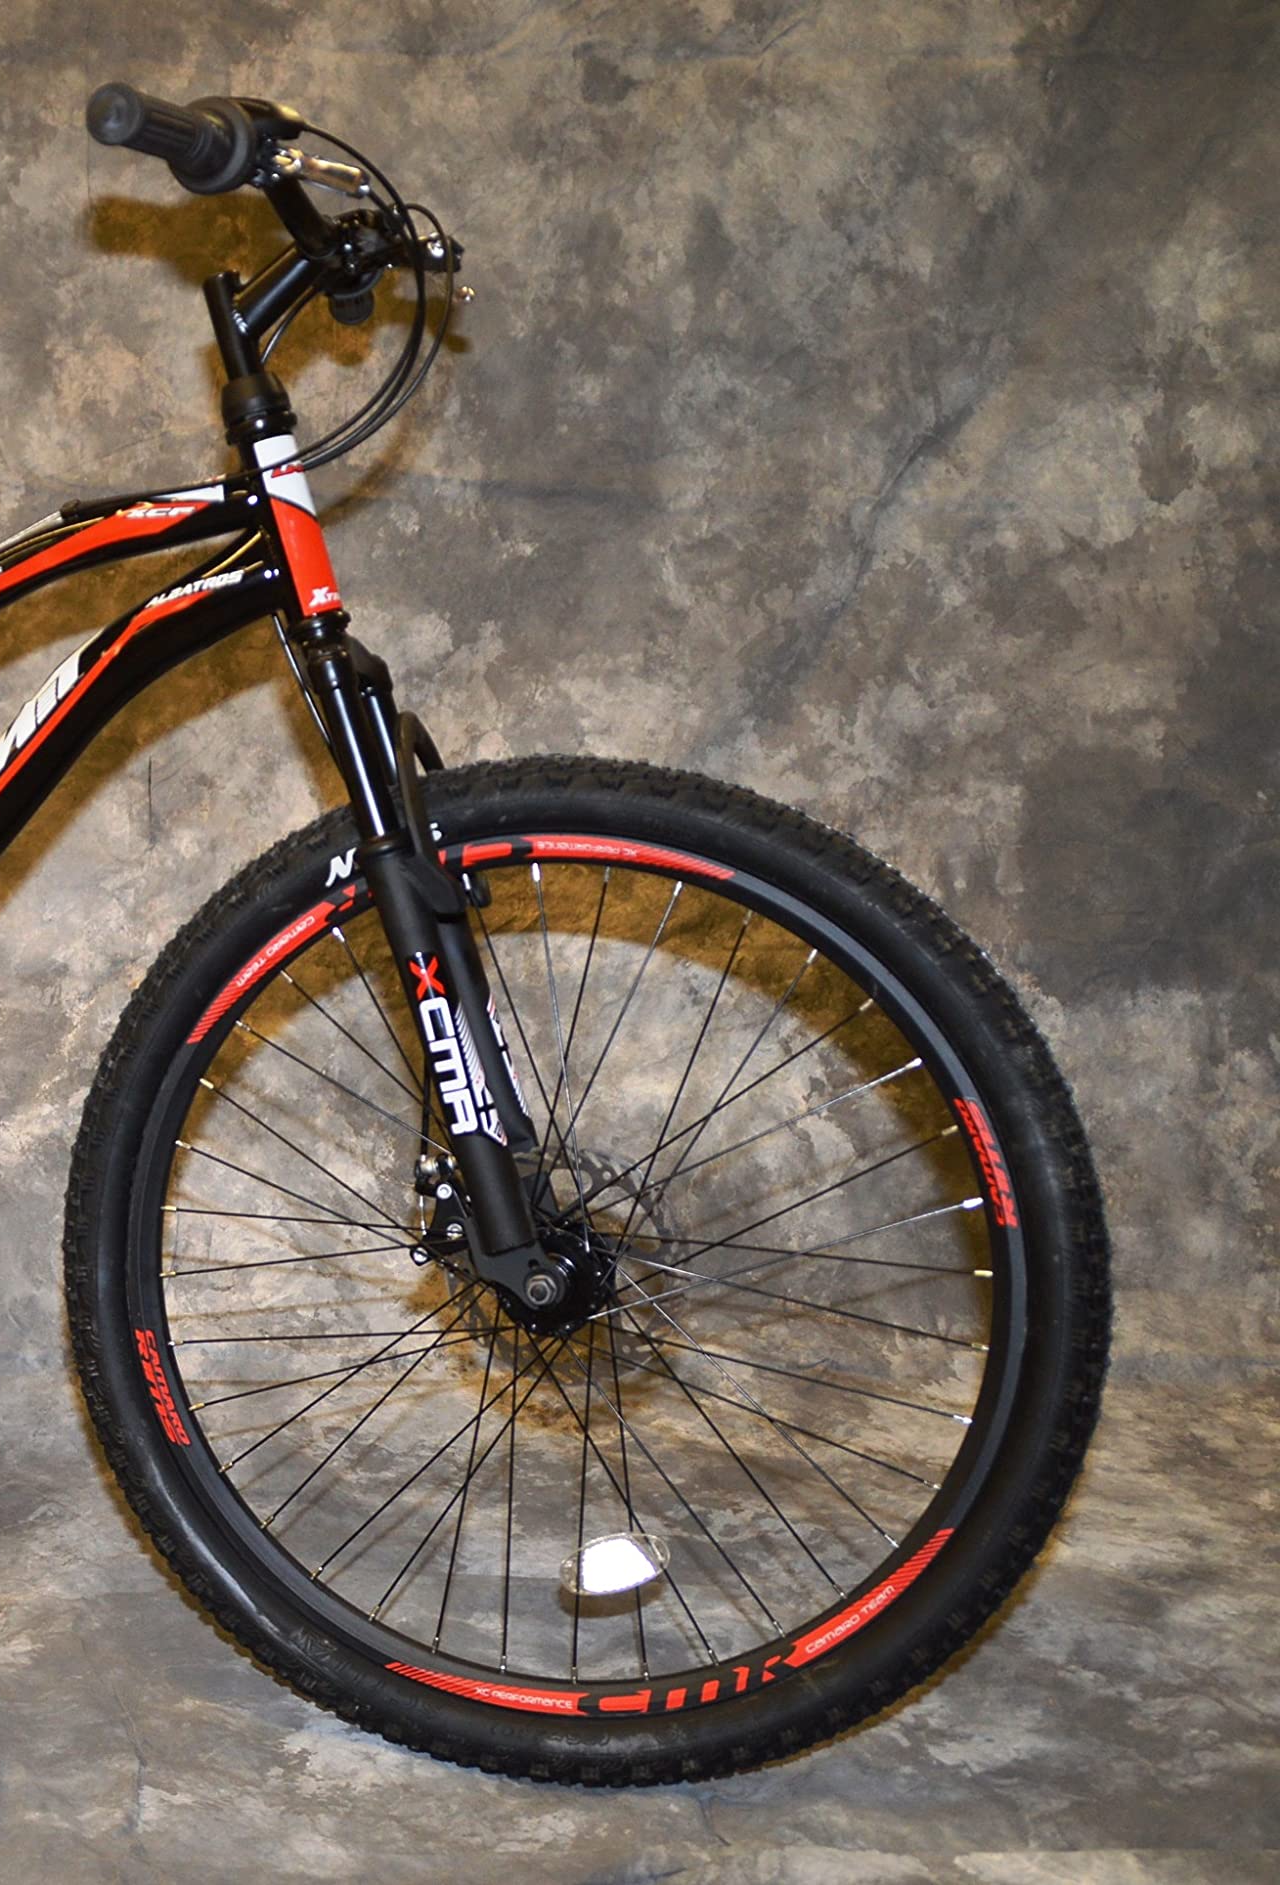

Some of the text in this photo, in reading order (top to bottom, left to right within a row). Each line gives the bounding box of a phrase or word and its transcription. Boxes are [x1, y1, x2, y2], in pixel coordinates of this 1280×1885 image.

[144, 569, 245, 609] ALBATROS
[134, 1328, 182, 1446] RIMS
[145, 1329, 192, 1446] CAMARO
[804, 1583, 896, 1655] CAMARO TEAM
[474, 1686, 573, 1710] XC PERFORMANCE
